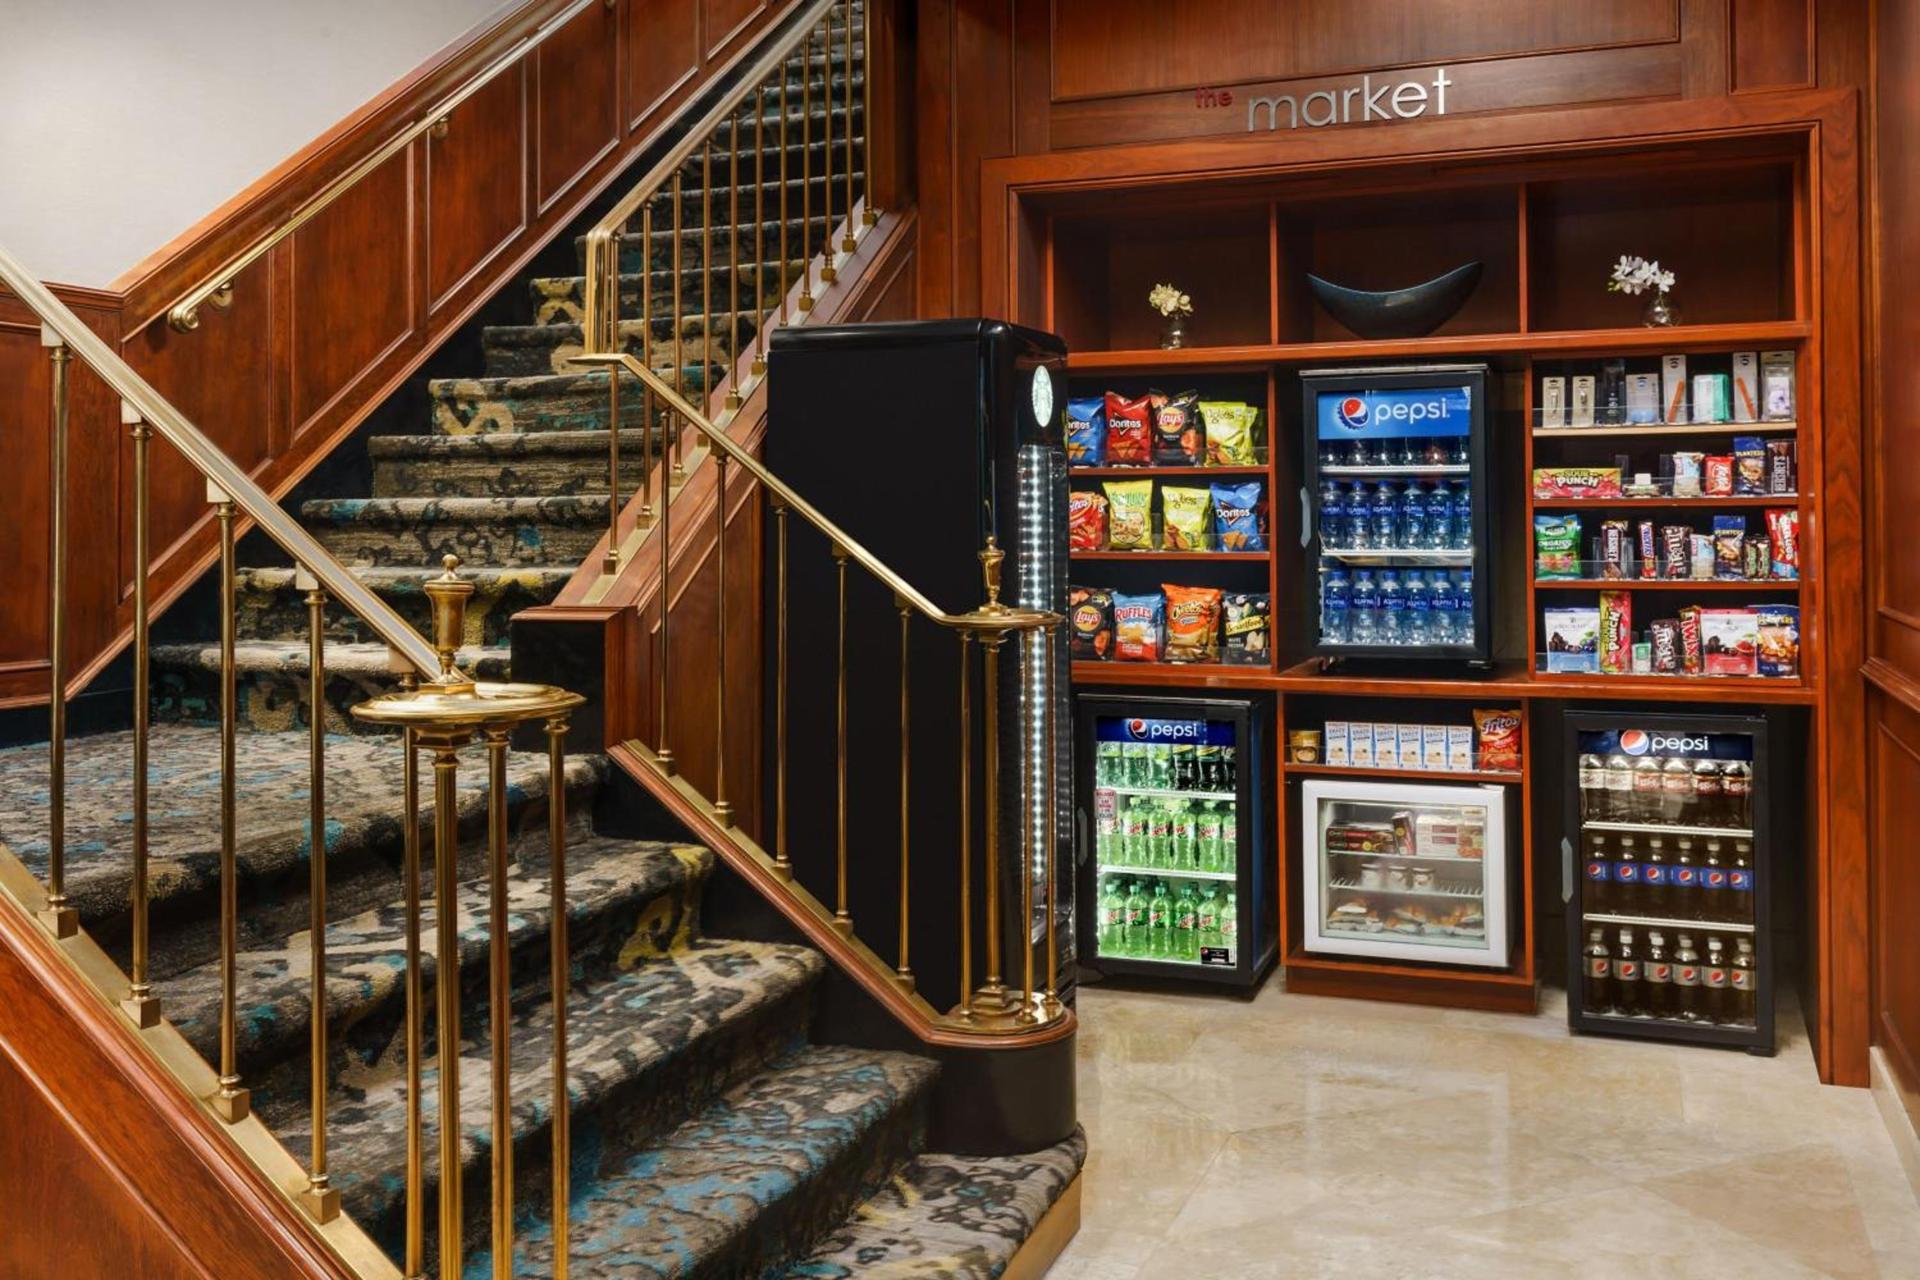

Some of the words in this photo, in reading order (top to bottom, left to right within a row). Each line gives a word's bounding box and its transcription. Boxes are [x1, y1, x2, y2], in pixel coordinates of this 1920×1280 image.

[1195, 86, 1234, 109] the
[1248, 68, 1453, 132] market
[1375, 397, 1447, 425] pepsi
[1109, 419, 1142, 430] Doritos
[1556, 475, 1600, 488] PUNCH
[1216, 507, 1251, 519] Doritos
[1114, 606, 1153, 622] RUFFLES
[1608, 610, 1622, 652] PUNCH
[1151, 723, 1197, 739] pepsi
[1481, 717, 1520, 735] Fritos
[1651, 735, 1709, 753] pepsi
